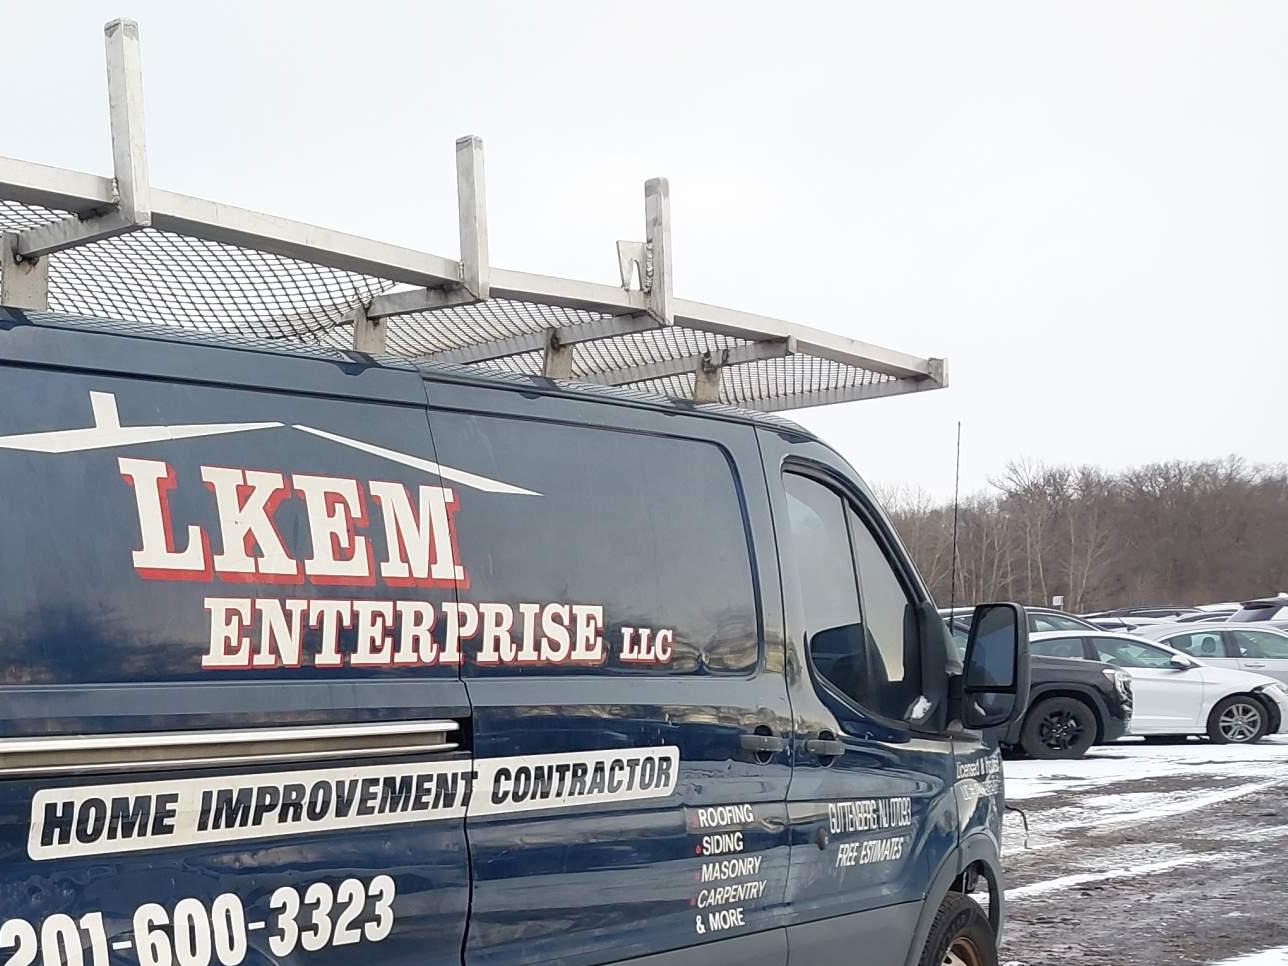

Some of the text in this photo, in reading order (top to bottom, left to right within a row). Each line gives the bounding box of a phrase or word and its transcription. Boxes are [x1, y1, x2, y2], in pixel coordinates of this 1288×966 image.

[117, 456, 470, 587] LKEM
[201, 596, 674, 669] ENTERPRISE LLC
[39, 755, 675, 847] HOME IMPROVEMENT CONTRACTOR
[697, 803, 754, 829] ROOFING
[701, 831, 744, 856] SIDING
[835, 836, 904, 868] FREE ESTIMATES
[701, 855, 762, 883] MASONRY
[697, 879, 767, 909] CARPENTRY
[695, 907, 746, 934] & MORE
